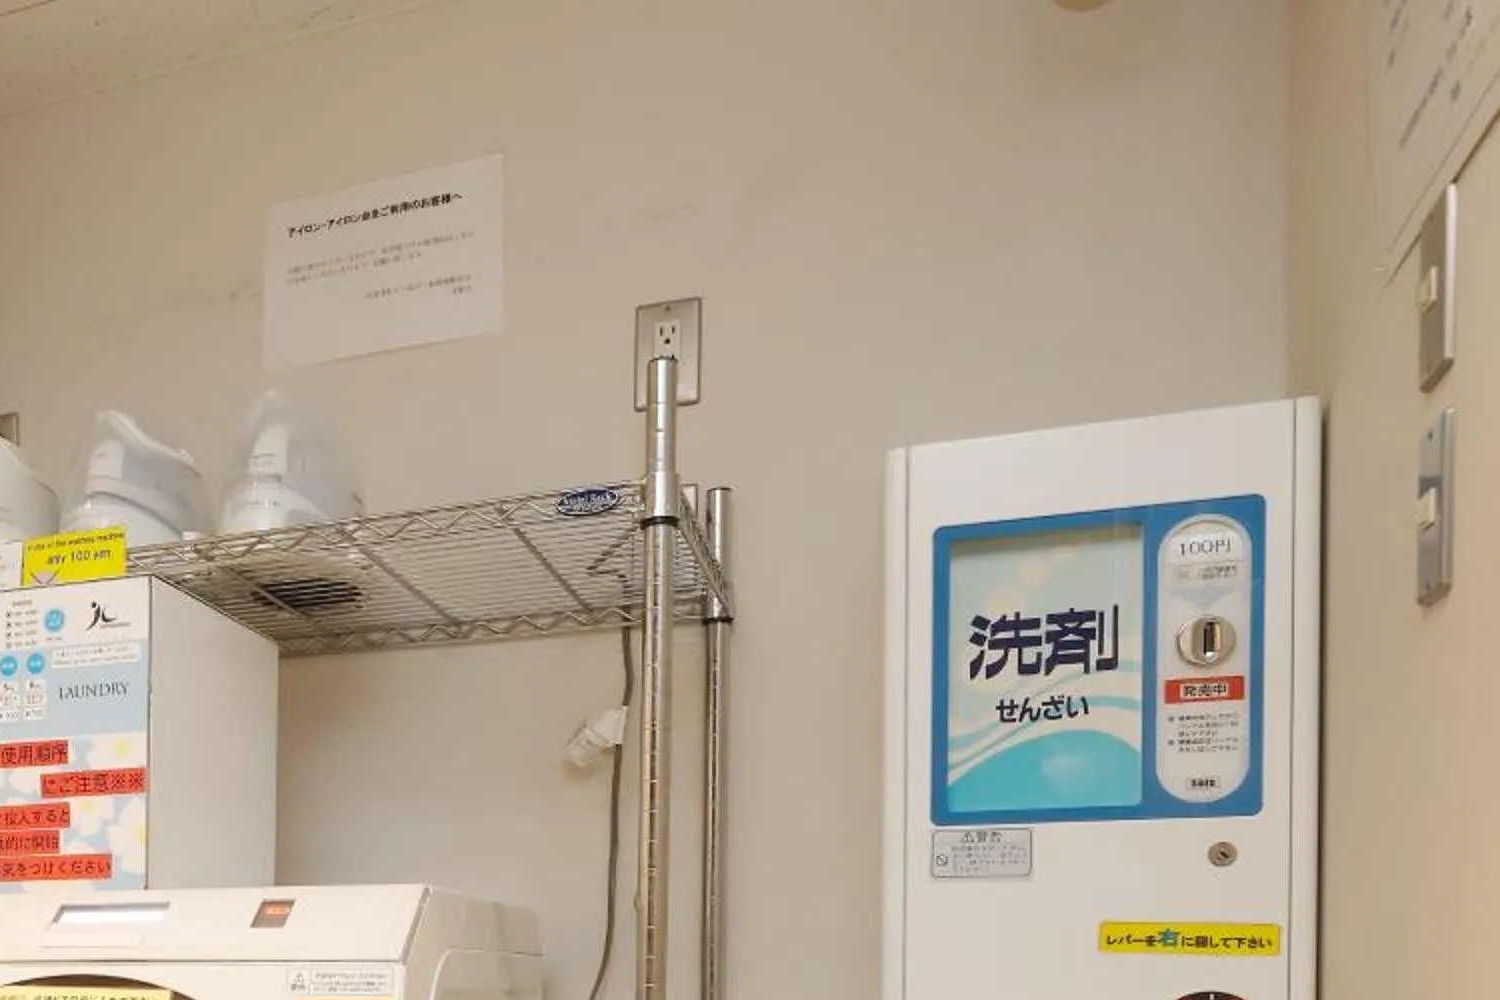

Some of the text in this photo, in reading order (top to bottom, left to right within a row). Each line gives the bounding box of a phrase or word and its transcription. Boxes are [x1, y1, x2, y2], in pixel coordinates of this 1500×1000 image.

[71, 550, 91, 561] 100
[1180, 537, 1231, 556] 100円
[968, 603, 1120, 680] 洗剤
[59, 681, 130, 701] LAUNDRY
[996, 696, 1090, 723] せんざい
[44, 771, 144, 793] にご注意※※
[1106, 928, 1272, 949] レバーを右に回して下さい
